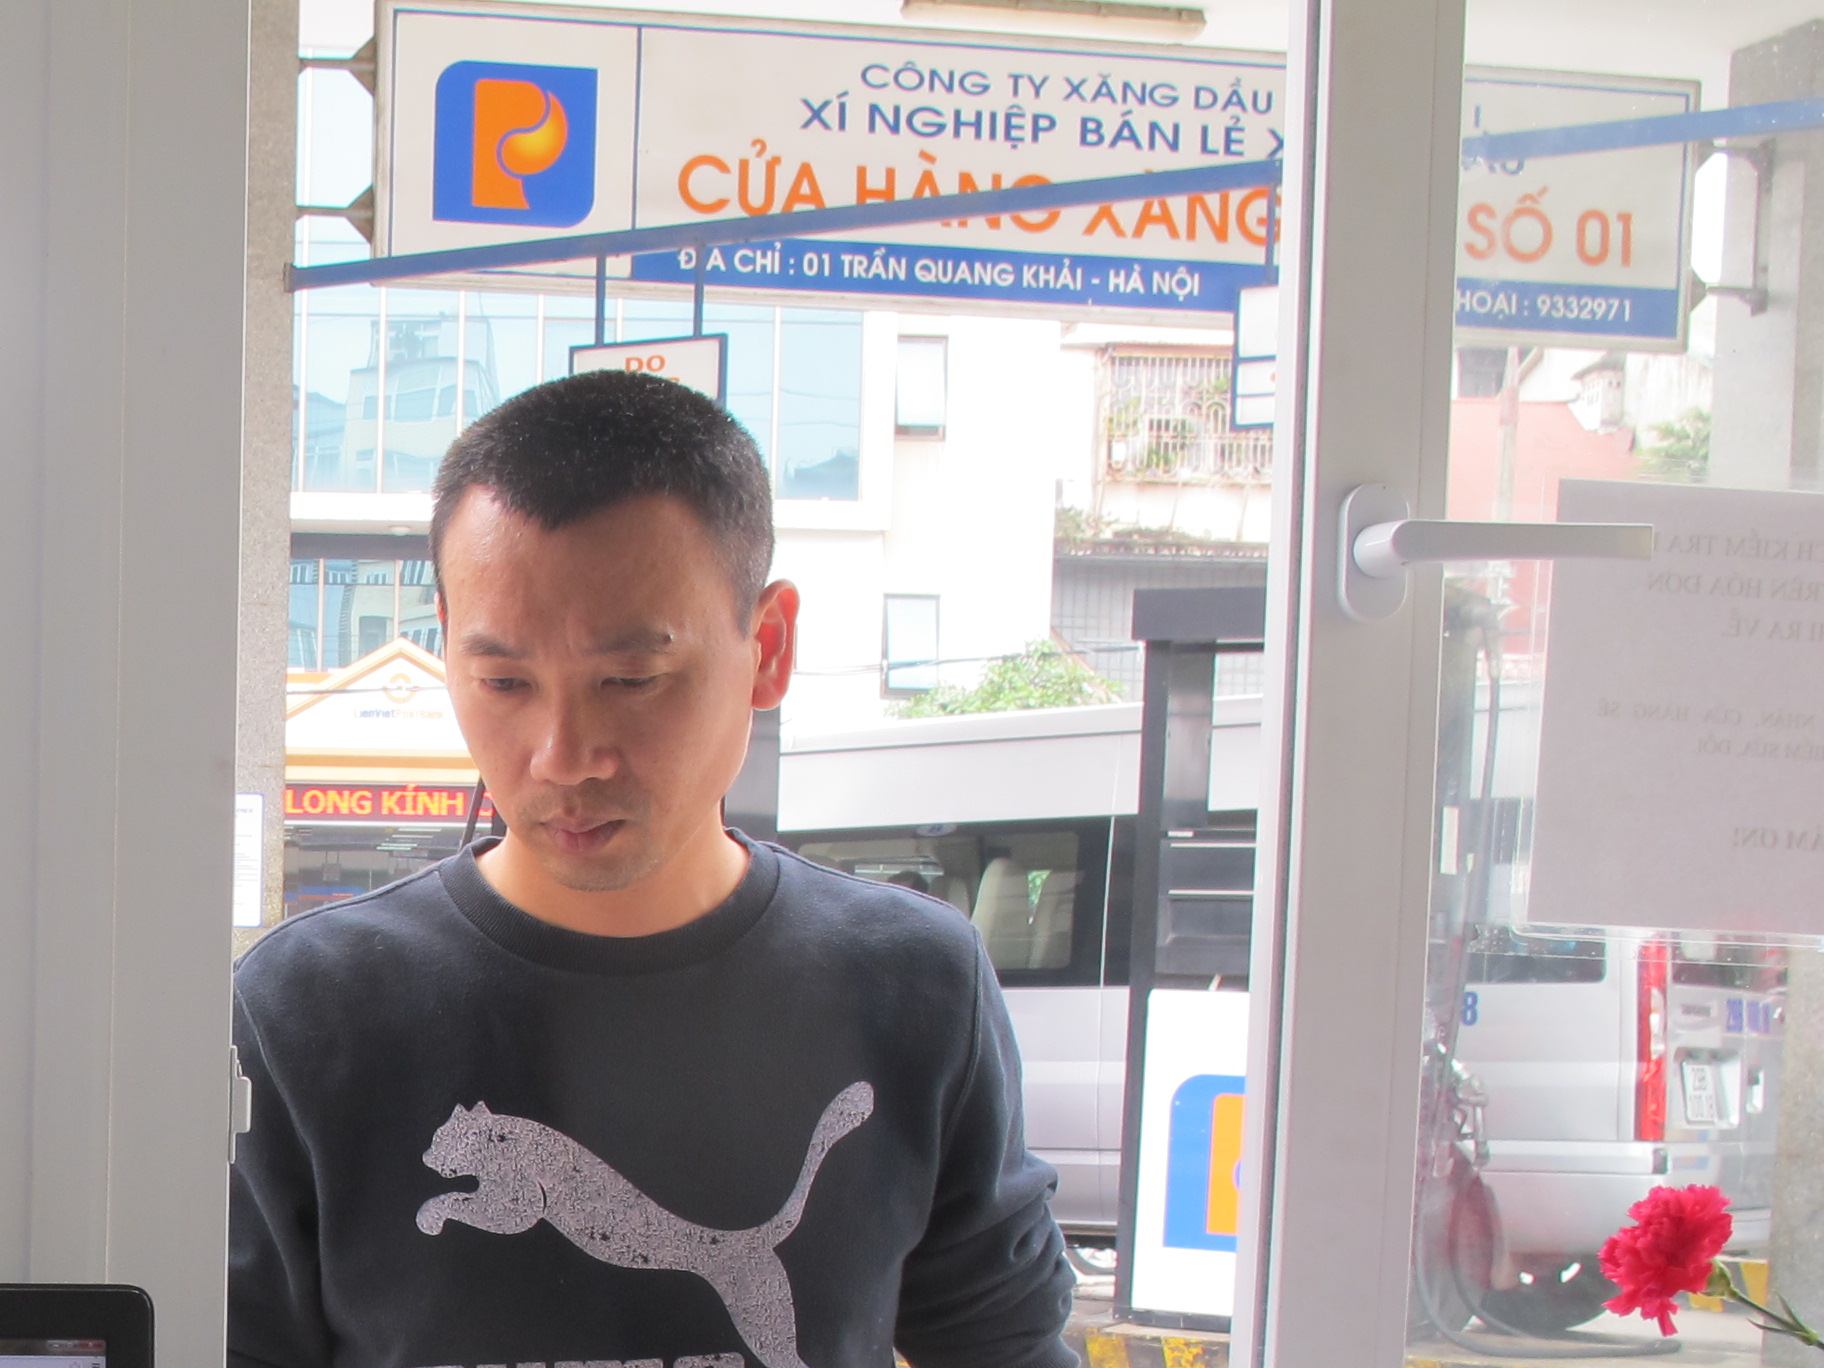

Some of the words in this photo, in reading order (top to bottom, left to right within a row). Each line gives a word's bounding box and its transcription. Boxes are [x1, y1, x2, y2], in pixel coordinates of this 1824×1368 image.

[861, 61, 991, 96] CÔNG
[1008, 73, 1049, 99] TY
[1064, 73, 1180, 107] XĂNG
[800, 90, 849, 132] XÍ
[868, 104, 1057, 150] NGHIỆP
[1080, 110, 1180, 153] BÁN
[1201, 116, 1246, 156] LẺ
[678, 139, 826, 215] CỬA
[1465, 186, 1554, 264] SỐ
[1577, 209, 1633, 268] 01
[678, 246, 727, 272] ĐA
[734, 243, 782, 274] CHỈ
[803, 254, 831, 277] 01
[841, 248, 907, 281] TRẦN
[915, 257, 1015, 288] QUANG
[1022, 257, 1083, 290] KHẢI
[1108, 264, 1145, 293] HÀ
[1152, 266, 1201, 302] NỘI
[1536, 294, 1631, 322] 9332971
[625, 354, 666, 373] DO
[285, 788, 373, 815] LONG
[381, 783, 465, 817] KÍNH
